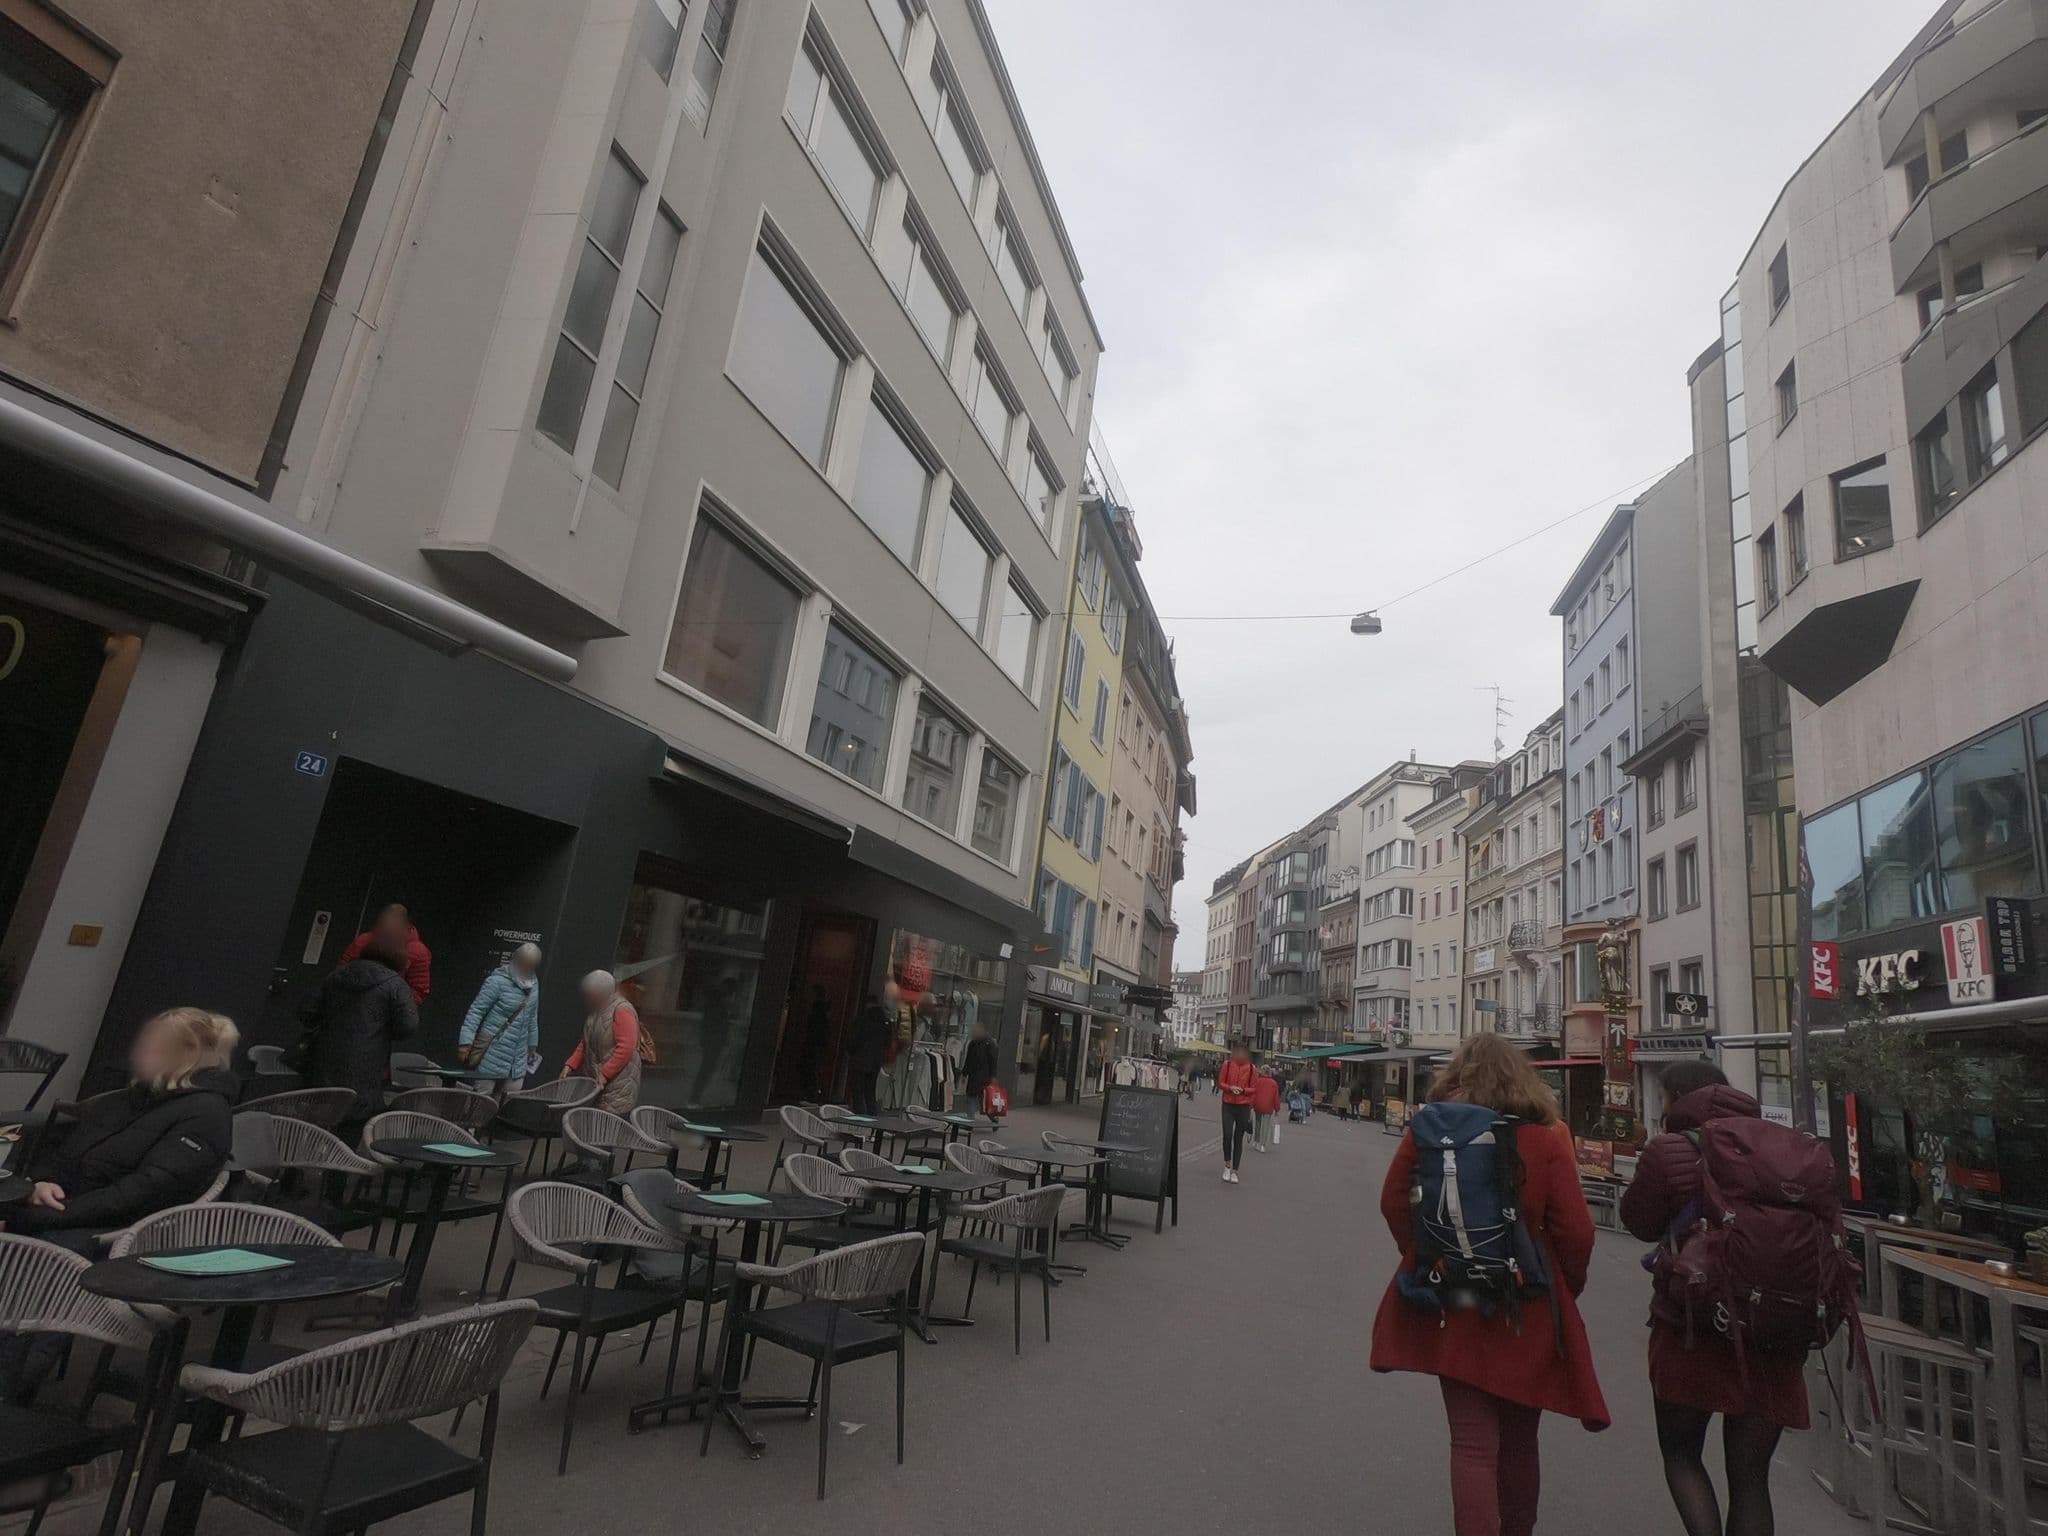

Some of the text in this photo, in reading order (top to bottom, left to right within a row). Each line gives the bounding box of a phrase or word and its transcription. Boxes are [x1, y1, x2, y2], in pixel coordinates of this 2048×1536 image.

[300, 755, 321, 772] 24
[493, 928, 543, 942] POWERHOUSE
[1811, 946, 1833, 994] KFC
[1856, 949, 1920, 997] KFC
[1049, 976, 1075, 996] ANOUK
[1956, 979, 1986, 998] KFC
[1846, 1125, 1861, 1182] KFC
